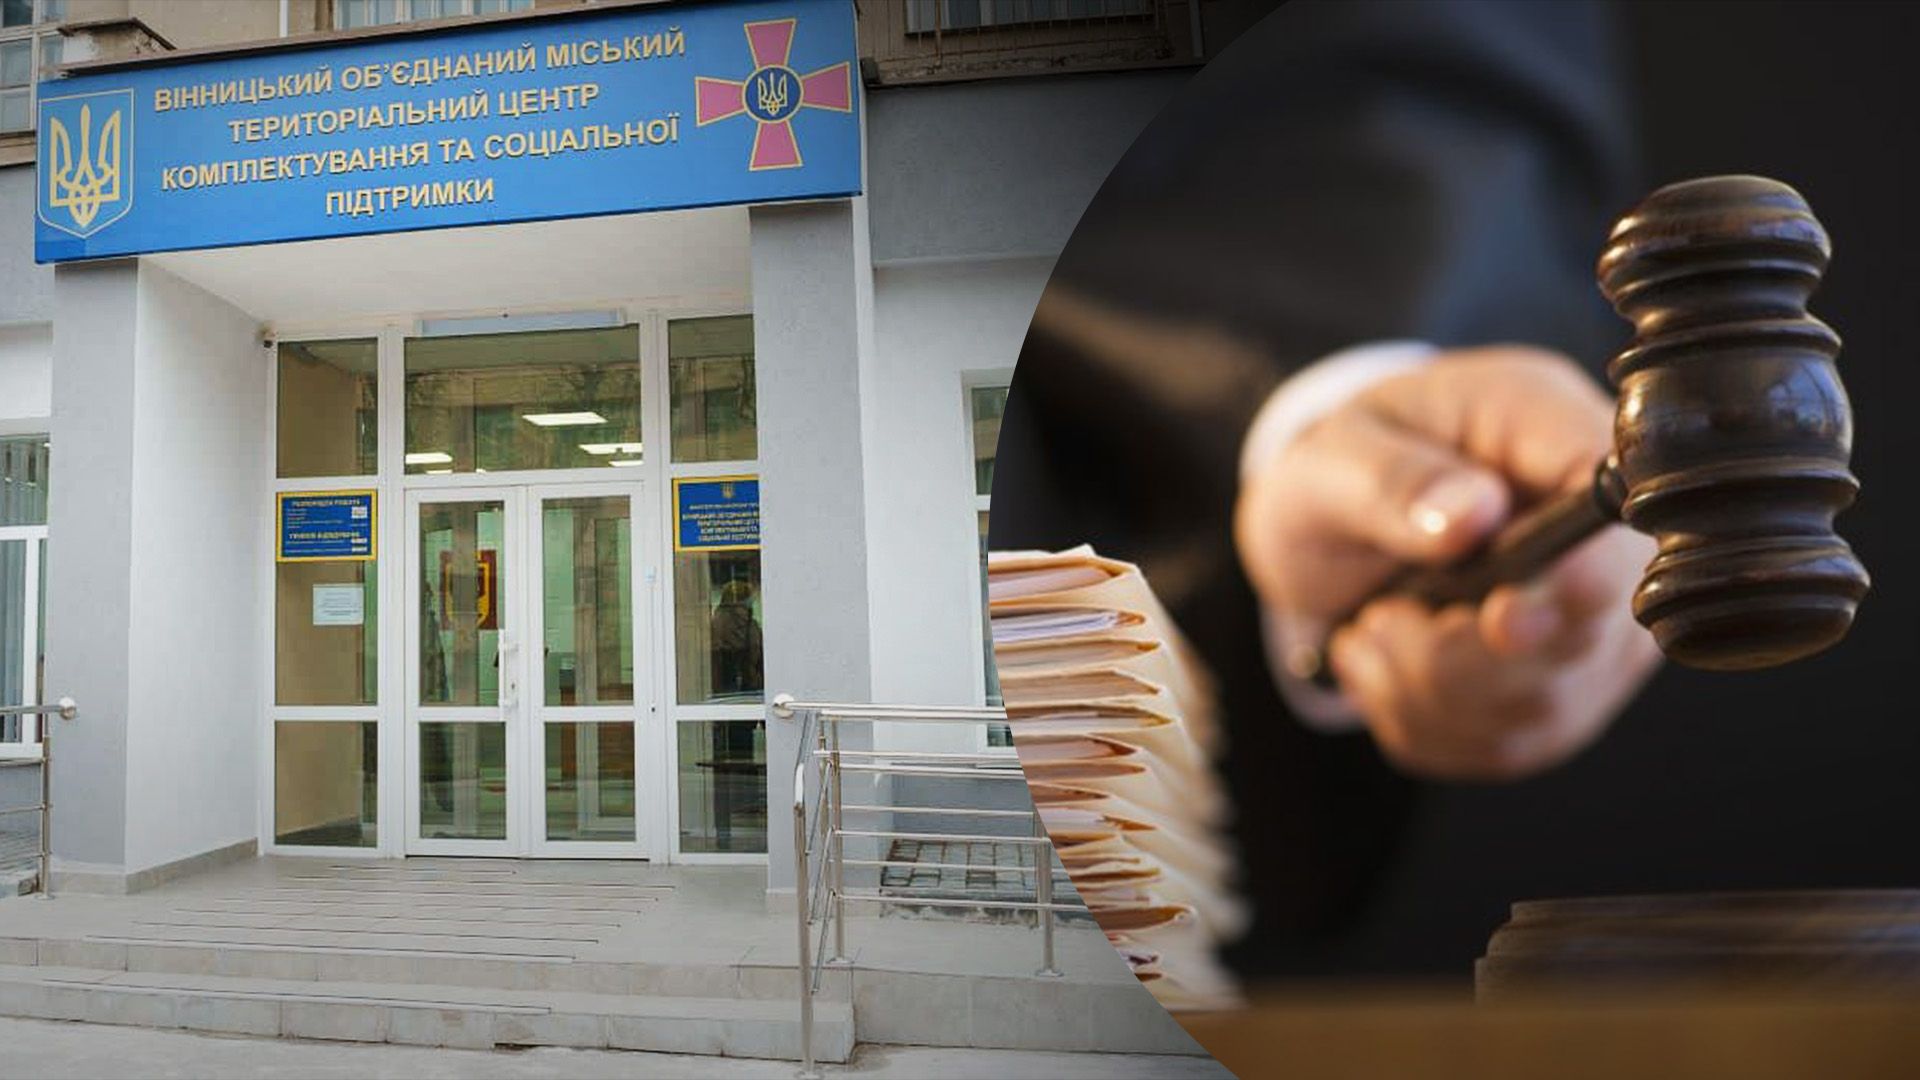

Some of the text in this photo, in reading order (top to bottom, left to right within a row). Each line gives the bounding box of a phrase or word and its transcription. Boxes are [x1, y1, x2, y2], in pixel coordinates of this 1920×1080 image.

[154, 27, 685, 111] ВІННИЦЬКИЙ ОБ’ЄДНАНИЙ МІСЬКИЙ
[228, 83, 599, 143] ТЕРИТОРІАЛЬНИЙ ЦЕНТР
[162, 113, 679, 190] КОМПЛЕКТУВАННЯ ТА СОЦІАЛЬНОЇ
[325, 177, 495, 219] ПІДТРИМКИ
